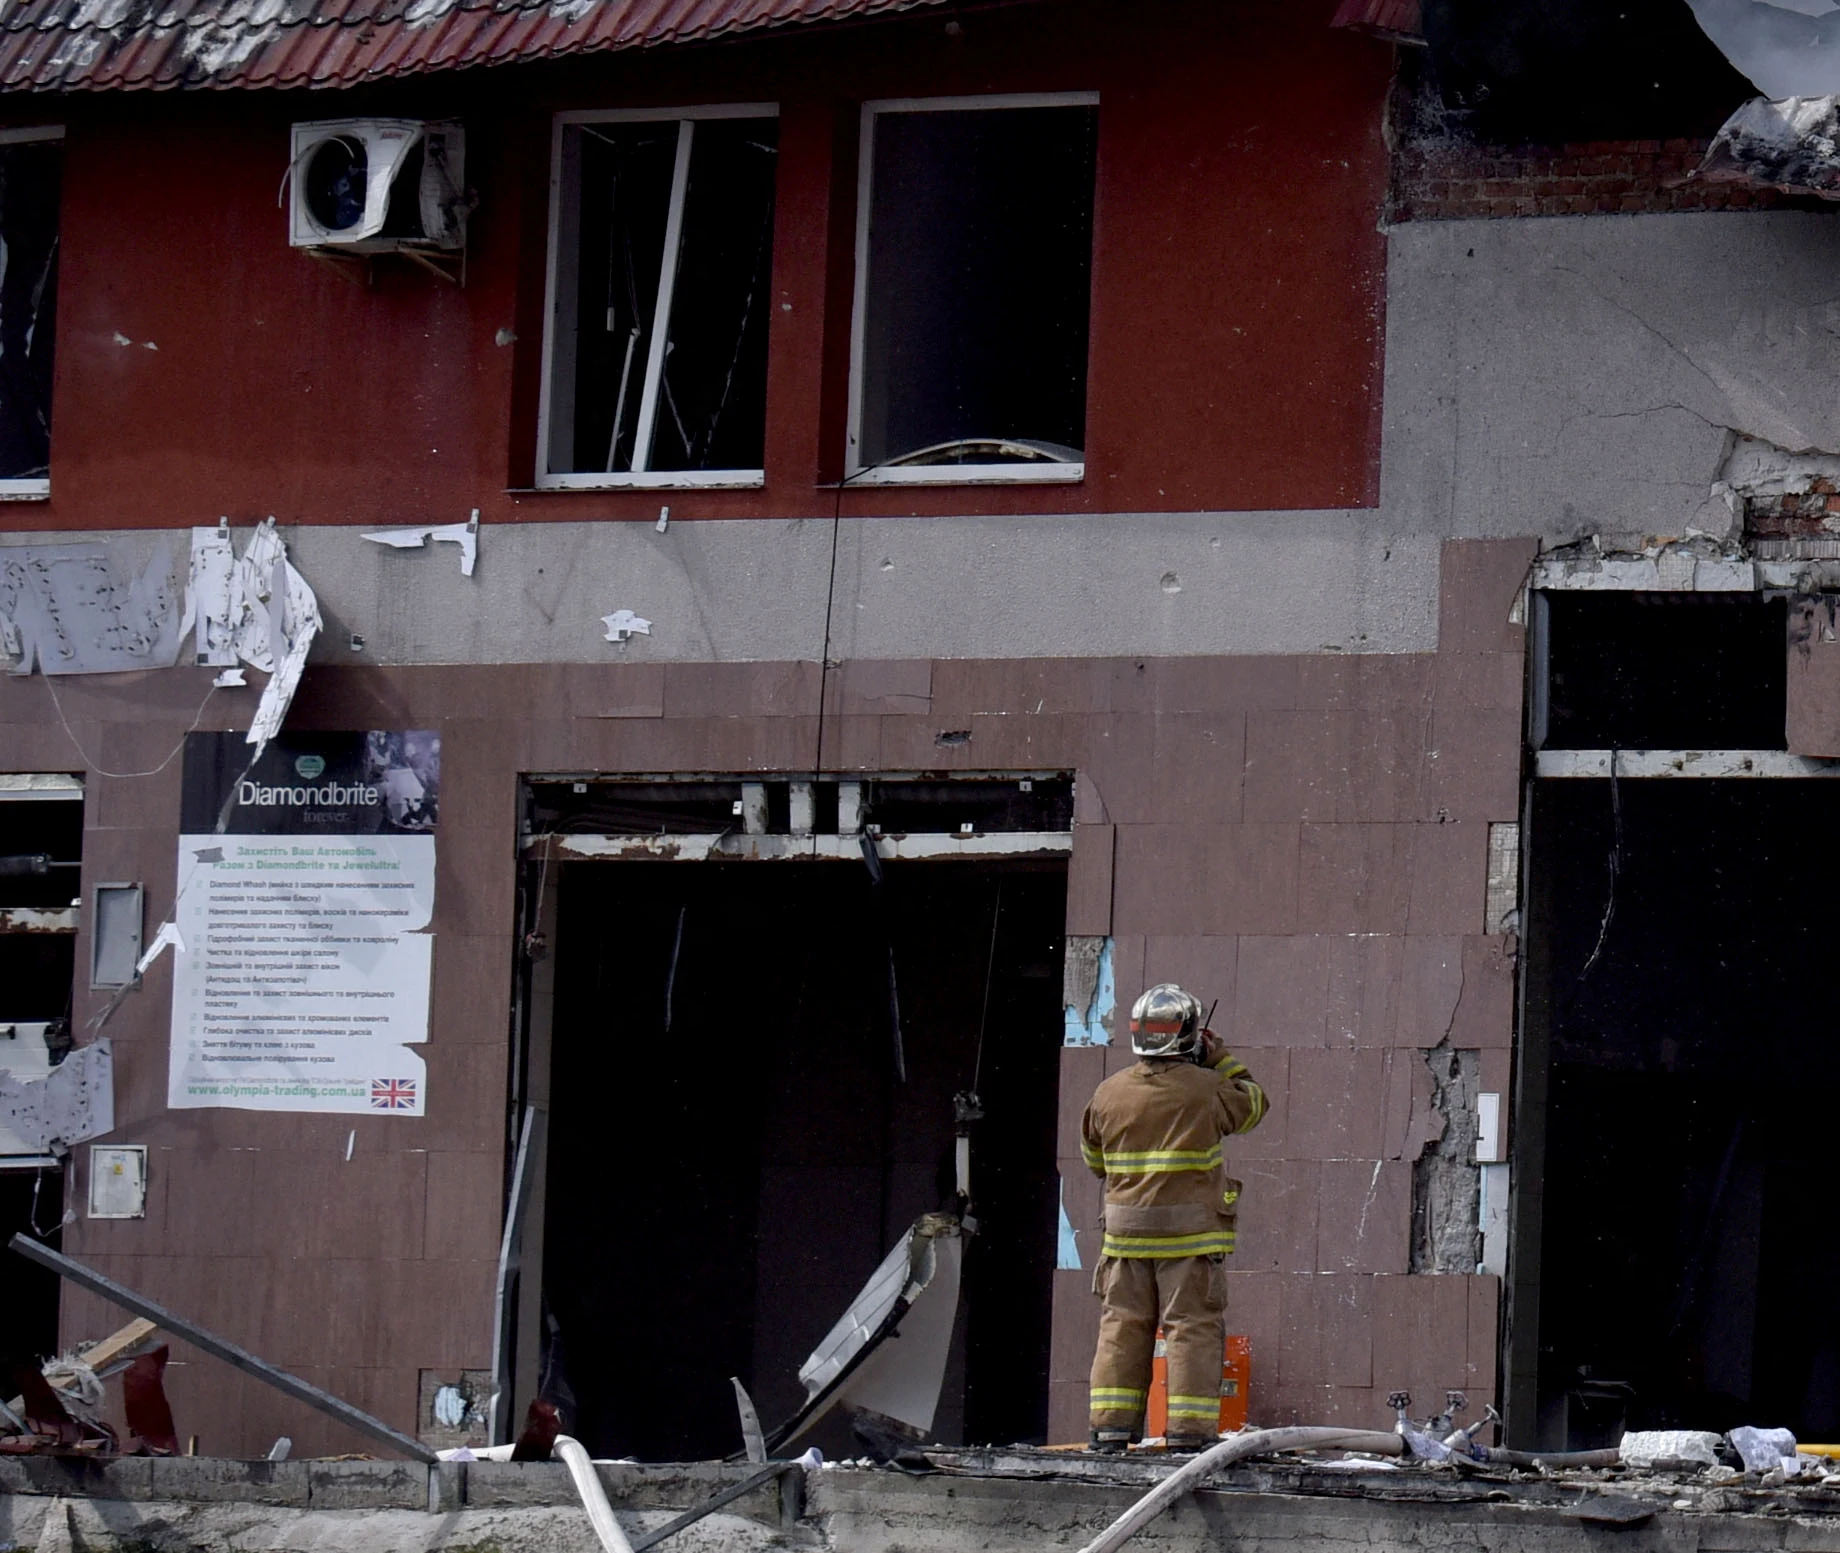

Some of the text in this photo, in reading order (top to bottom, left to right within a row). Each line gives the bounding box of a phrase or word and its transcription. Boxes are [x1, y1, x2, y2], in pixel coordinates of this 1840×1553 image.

[239, 781, 378, 805] Diamondbrite
[291, 846, 314, 856] Ваш
[256, 860, 325, 870] Diamondbrite
[328, 862, 340, 870] та
[188, 1083, 366, 1098] www.olympia-trading.com.ua
